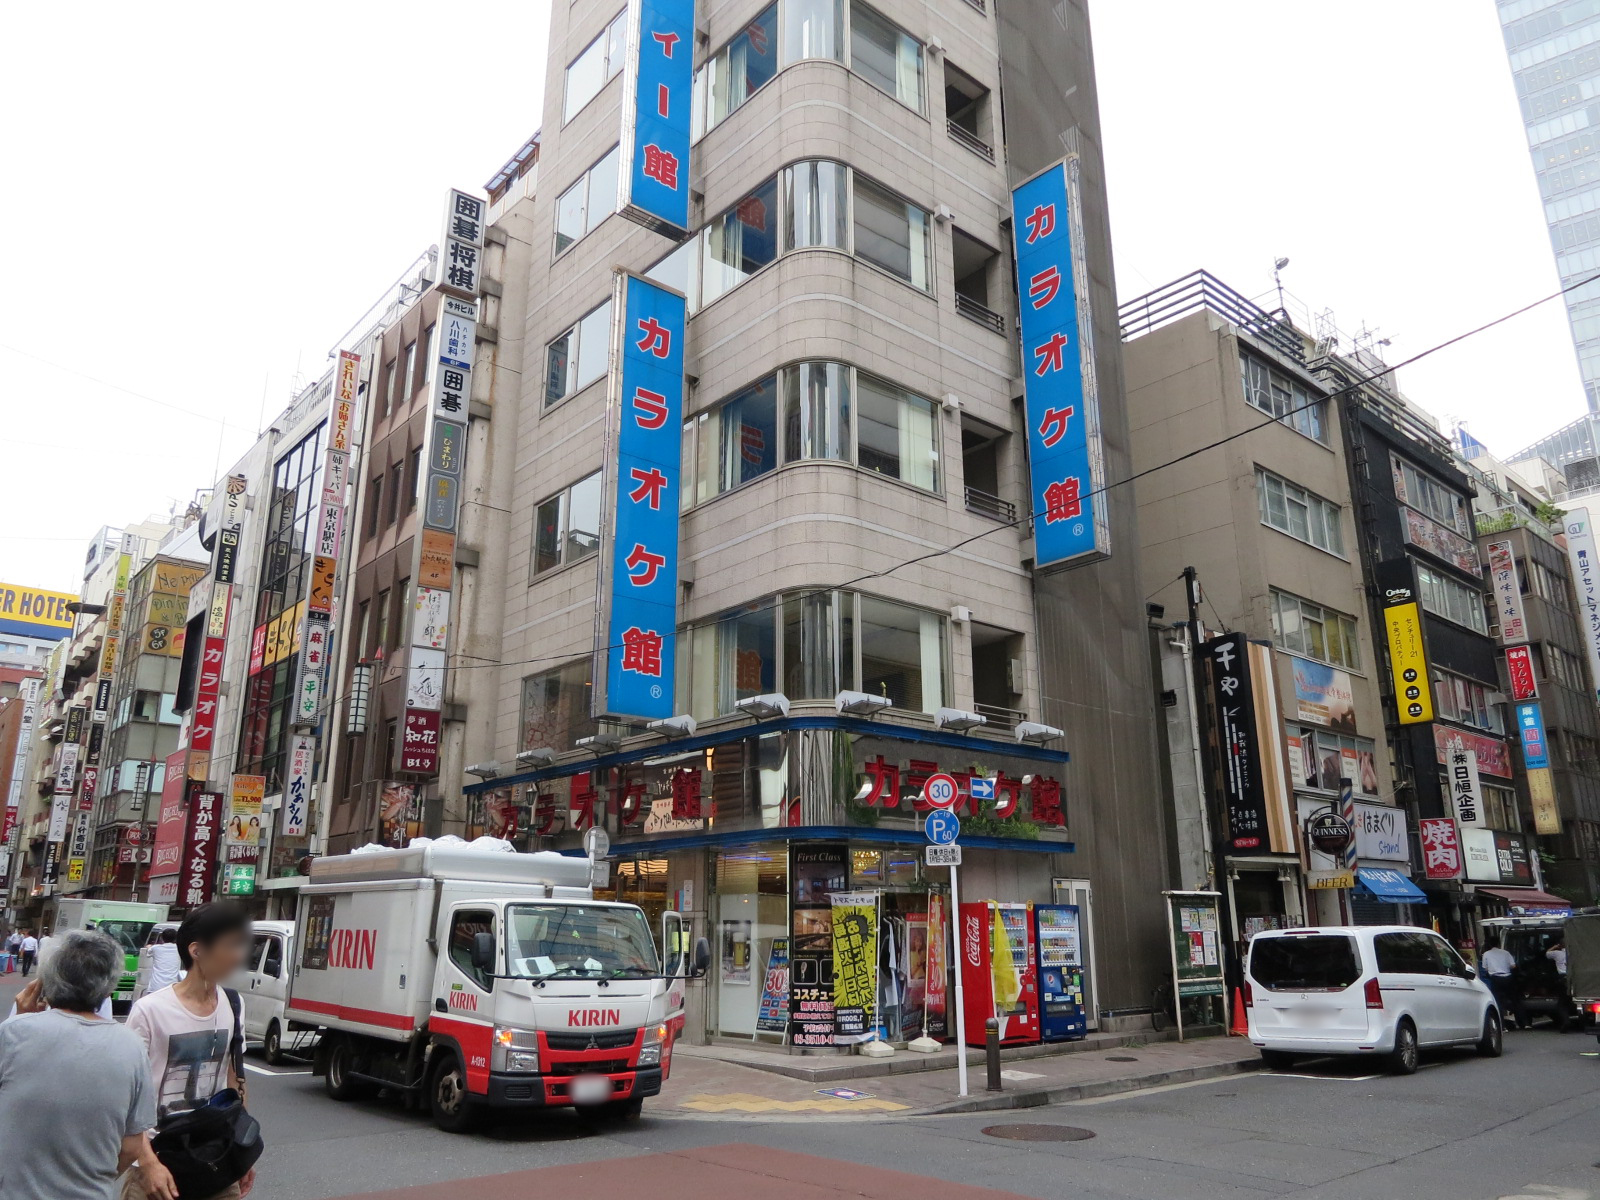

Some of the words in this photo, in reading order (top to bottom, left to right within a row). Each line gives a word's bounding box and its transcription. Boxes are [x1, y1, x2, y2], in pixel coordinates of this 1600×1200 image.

[447, 320, 460, 357] 八川歯科
[1025, 203, 1082, 526] カラオケ館
[440, 369, 464, 413] 囲碁
[621, 316, 671, 678] カラオケ館
[320, 507, 338, 555] 東京駅店
[19, 592, 72, 622] HOTEL
[308, 631, 323, 664] 麻雀
[193, 648, 223, 739] カラオケ
[302, 680, 317, 713] 平安
[1522, 707, 1536, 726] 麻雀
[405, 725, 437, 744] 知花
[406, 758, 421, 767] B1
[932, 783, 951, 799] 30
[932, 819, 946, 841] P
[942, 830, 953, 841] 60
[1312, 827, 1348, 837] GUINNESS
[1363, 810, 1395, 836] はまぐり
[186, 794, 216, 905] 背が高くなる靴
[797, 852, 818, 862] First
[818, 852, 842, 862] Class
[1422, 820, 1457, 869] 焼肉
[1316, 877, 1348, 888] BEER
[328, 929, 377, 971] KIRIN
[449, 991, 478, 1012] KIRIN
[568, 1009, 620, 1026] KIRIN
